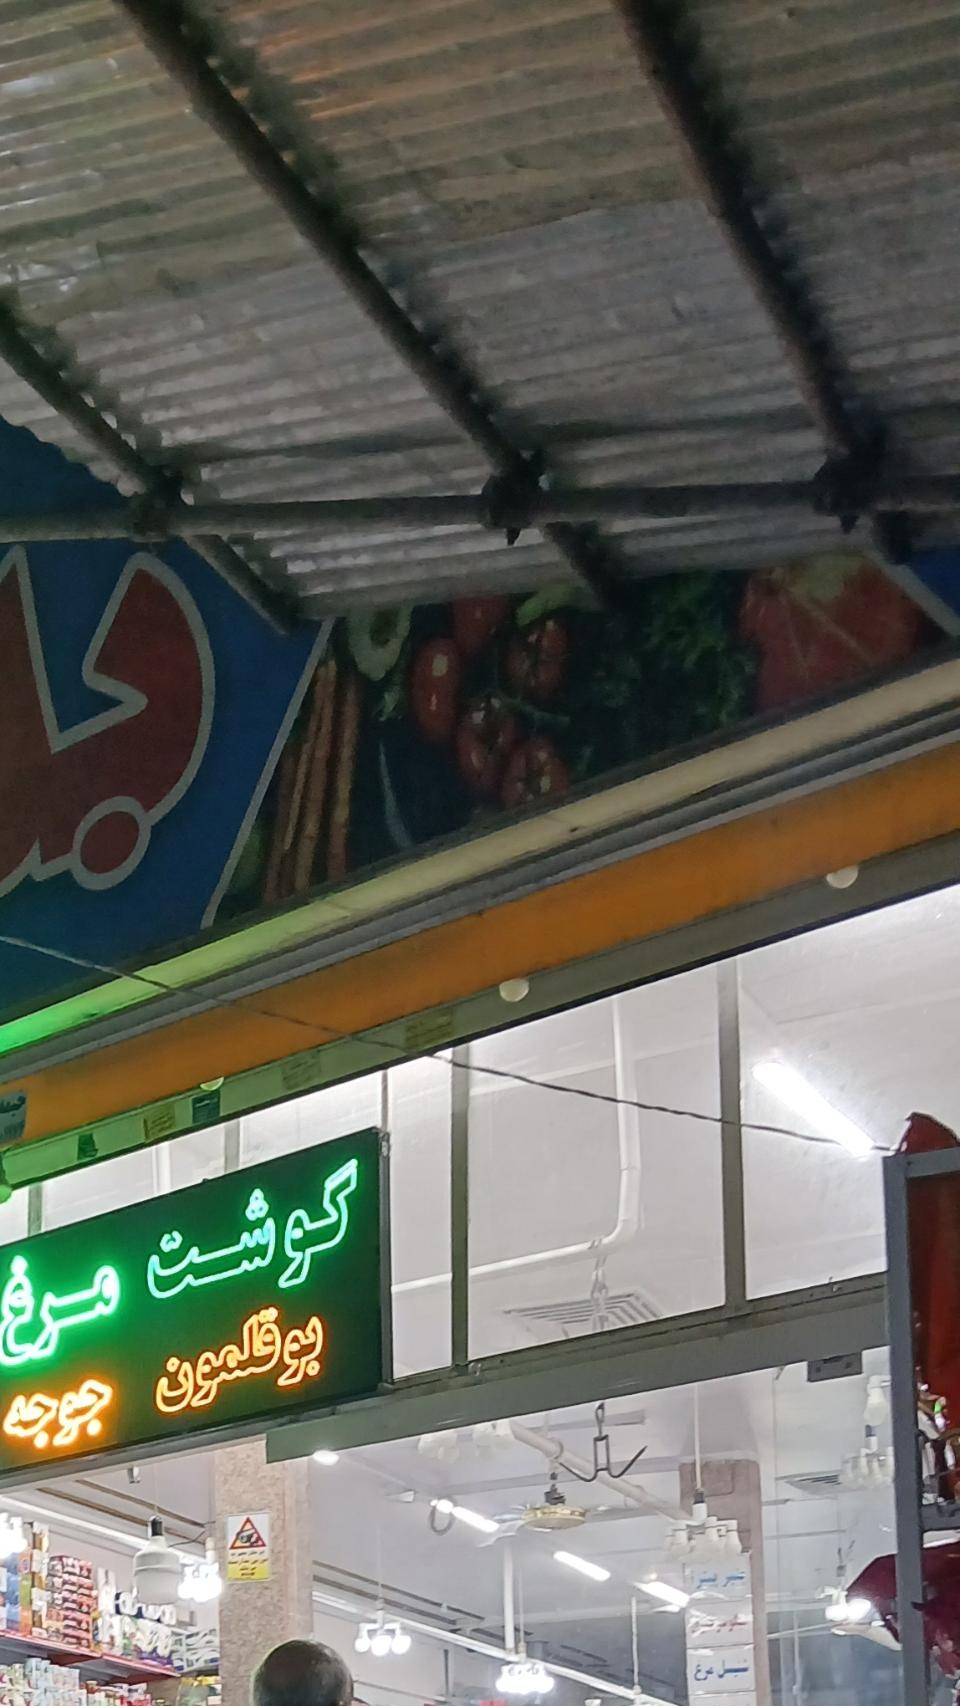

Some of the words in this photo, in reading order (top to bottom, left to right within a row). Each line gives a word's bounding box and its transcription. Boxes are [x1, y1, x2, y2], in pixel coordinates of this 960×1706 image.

[146, 1158, 359, 1295] گوشت
[3, 1379, 113, 1444] جوجه
[155, 1304, 325, 1413] بوقلمون
